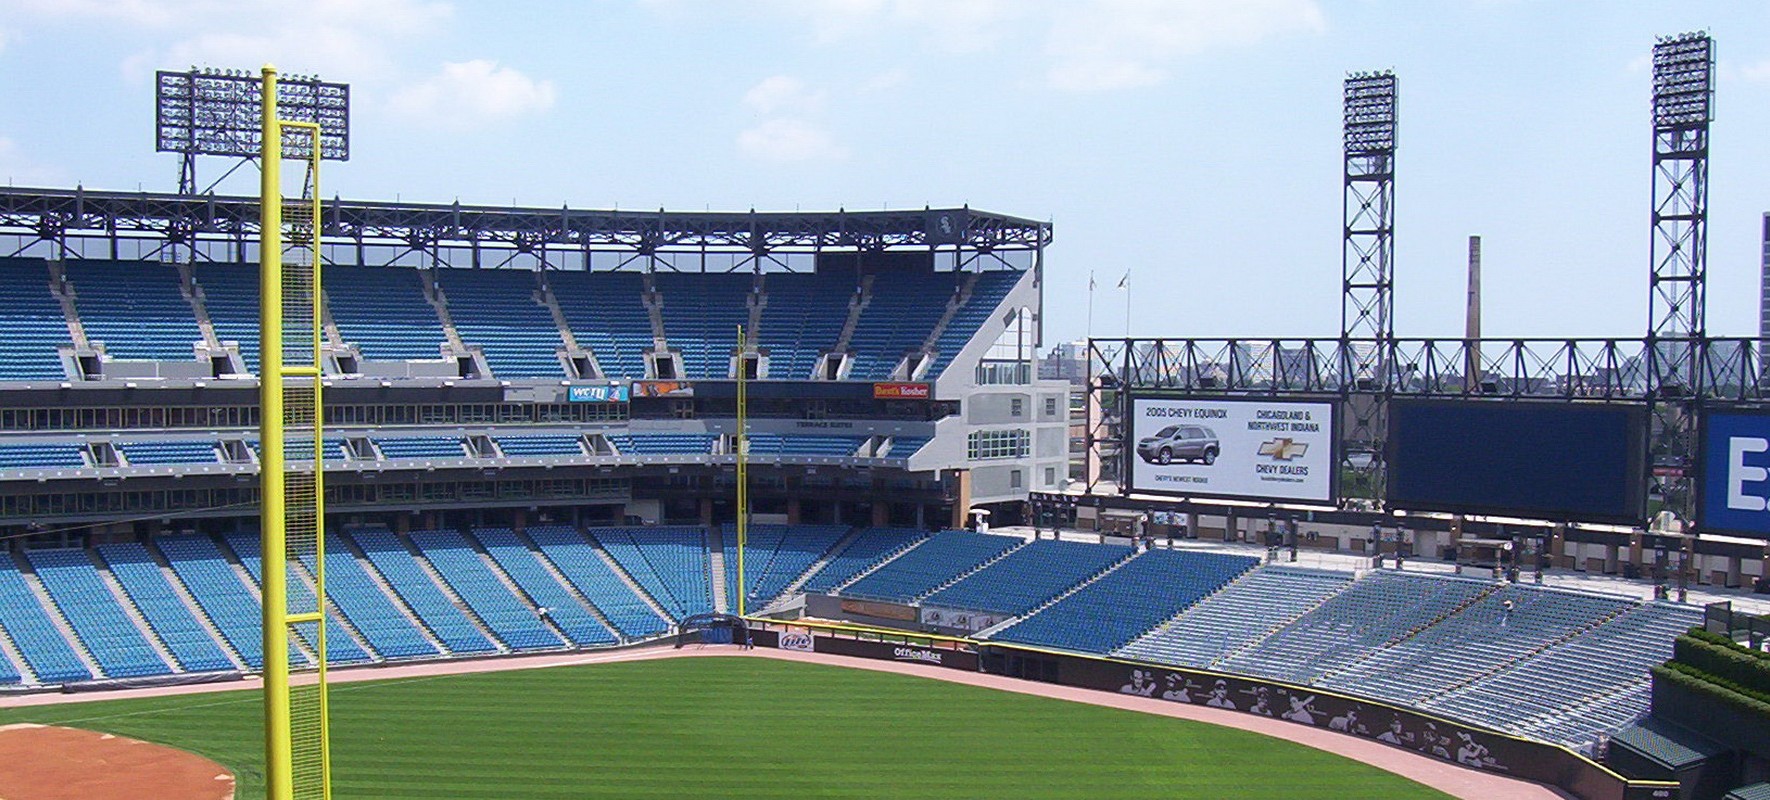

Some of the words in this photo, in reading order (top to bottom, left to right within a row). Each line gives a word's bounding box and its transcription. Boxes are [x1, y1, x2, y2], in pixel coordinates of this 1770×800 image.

[900, 385, 928, 396] Kosher
[1146, 407, 1167, 418] 2005
[1168, 407, 1193, 418] CHEVY
[1194, 408, 1228, 419] EQUINOX
[1256, 410, 1304, 421] CHICAGOLAND
[1304, 411, 1312, 421] &
[1247, 422, 1289, 432] NORTHWEST
[1290, 423, 1320, 433] INDIANA
[1256, 464, 1278, 475] CHEVY
[1279, 465, 1309, 476] DEALERS
[1727, 436, 1770, 511] E
[893, 647, 942, 661] OfficeMax
